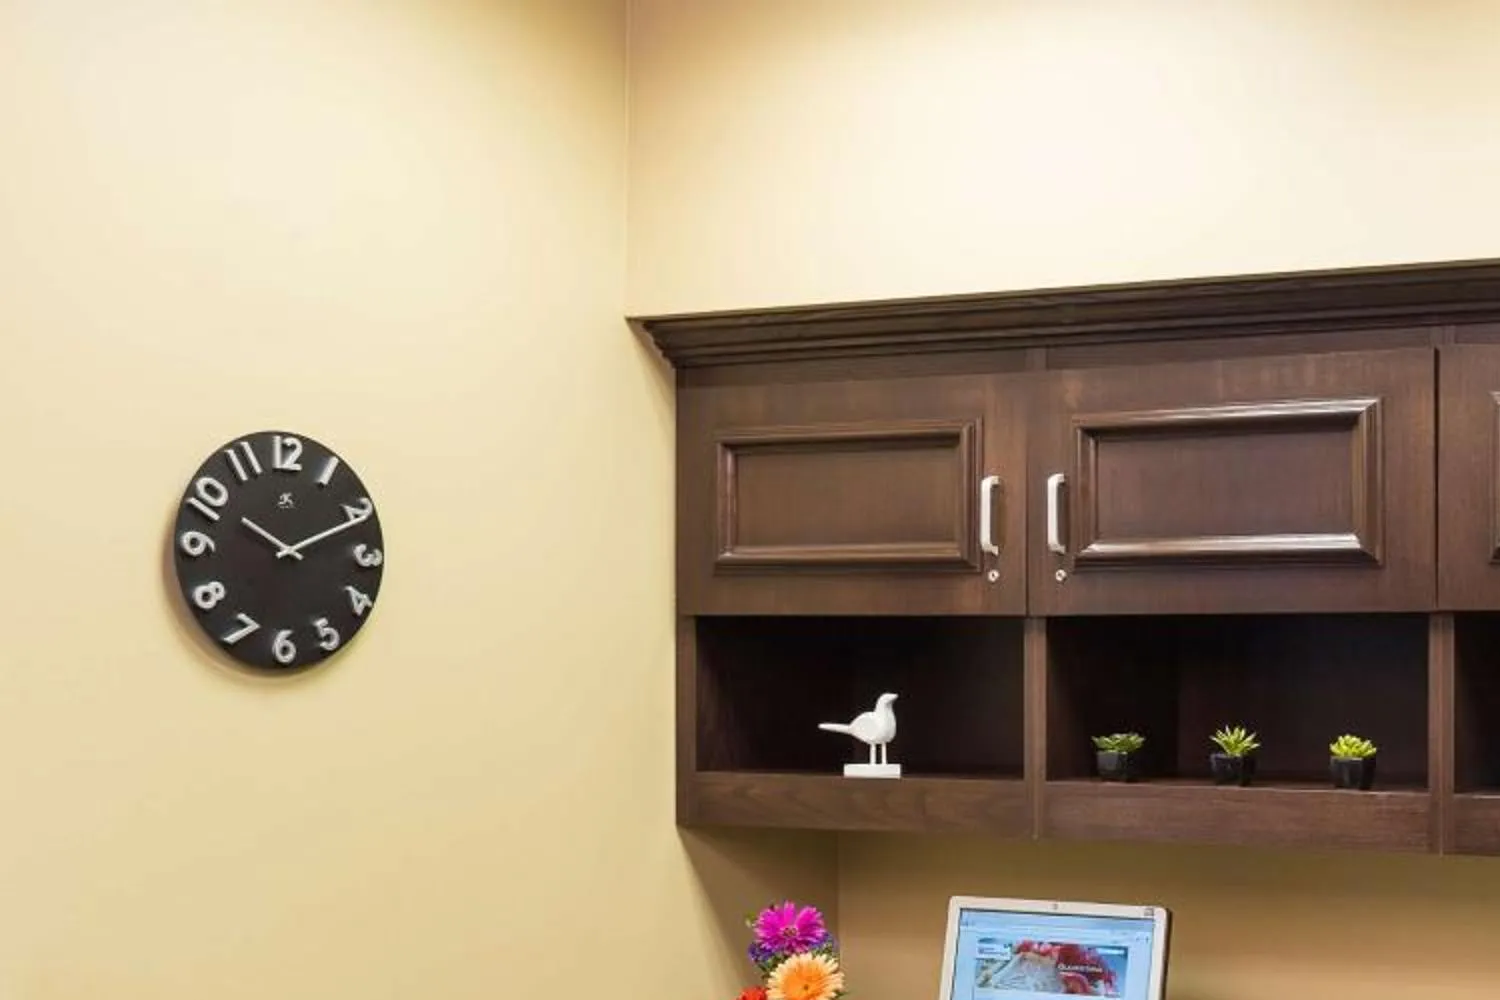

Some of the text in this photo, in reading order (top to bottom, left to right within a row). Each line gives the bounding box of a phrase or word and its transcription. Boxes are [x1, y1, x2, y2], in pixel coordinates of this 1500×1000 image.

[225, 441, 262, 481] 11
[273, 436, 303, 471] 12
[317, 456, 339, 485] 1
[188, 477, 229, 521] 10
[340, 498, 373, 522] 2
[180, 531, 215, 556] 9
[353, 544, 382, 568] 3
[193, 582, 226, 609] 8
[345, 586, 372, 615] 4
[222, 613, 260, 644] 7
[313, 618, 340, 650] 5
[272, 629, 296, 663] 6
